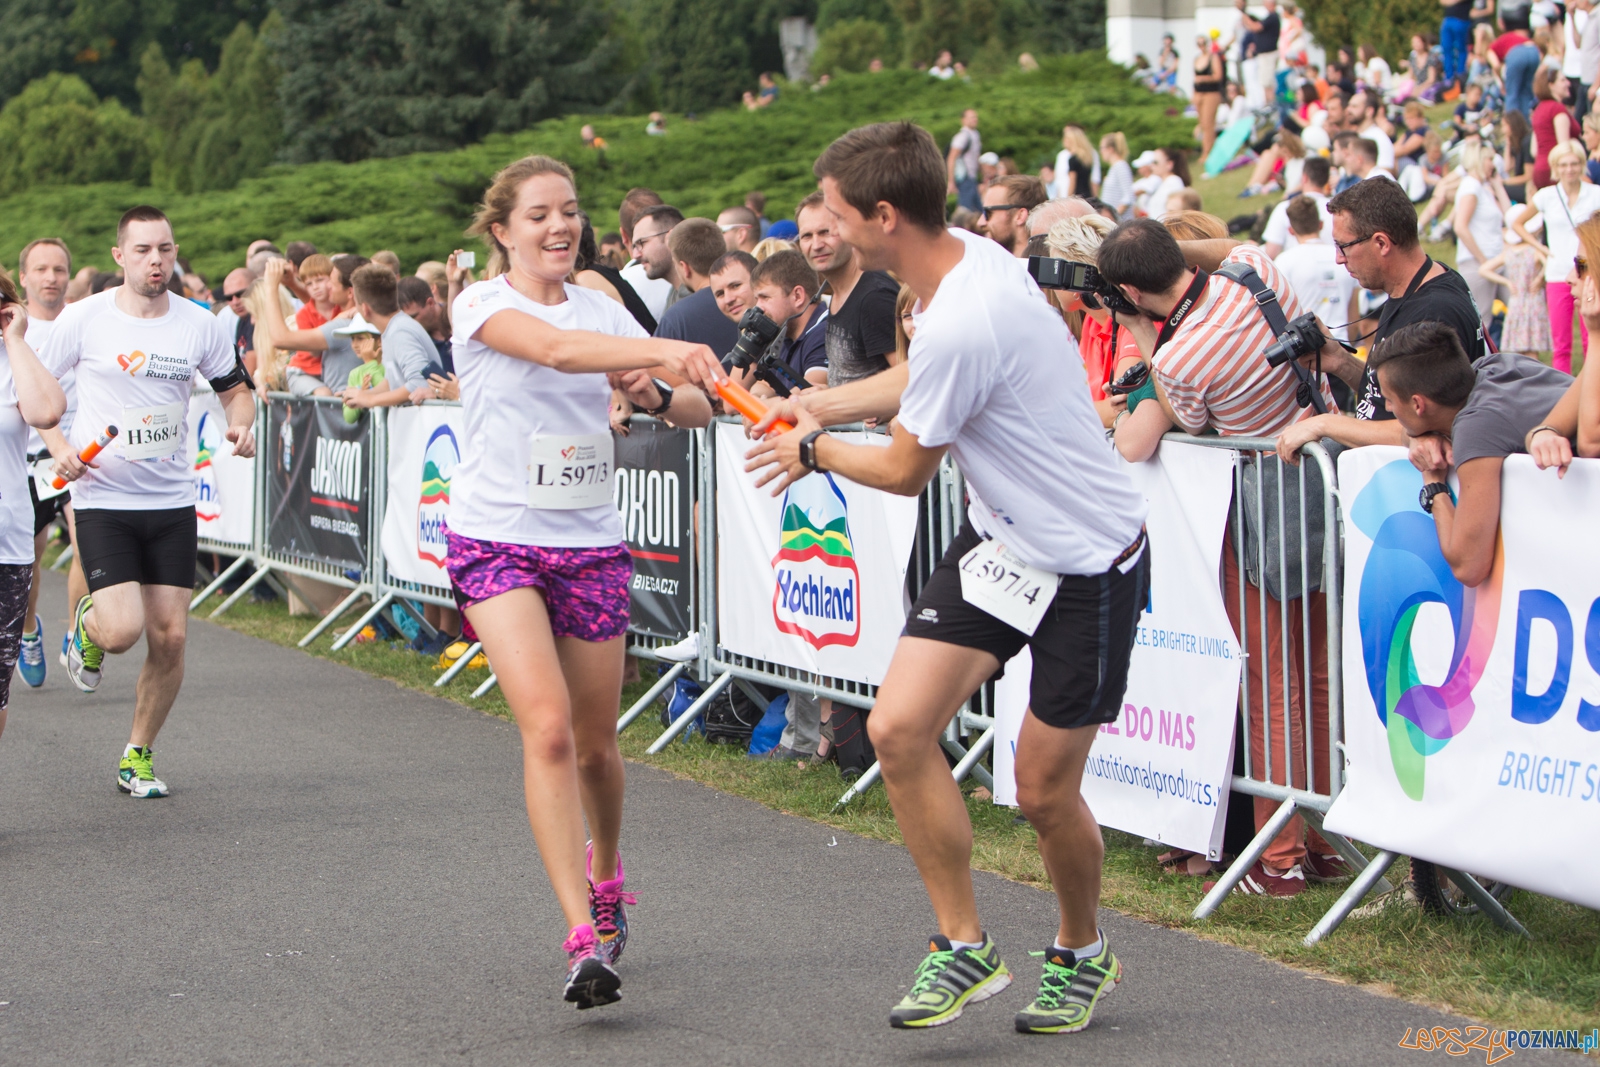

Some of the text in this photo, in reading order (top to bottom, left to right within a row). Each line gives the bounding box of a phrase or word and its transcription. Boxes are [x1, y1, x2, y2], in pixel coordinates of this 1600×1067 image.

[1170, 298, 1192, 326] Canon
[148, 361, 191, 374] Business
[150, 353, 188, 365] Poznań
[146, 369, 191, 382] Run 2016
[614, 467, 680, 548] AXON
[420, 511, 449, 545] Hochl
[632, 573, 680, 596] BIEGACZY
[1152, 628, 1197, 654] BRIGHTER
[1198, 636, 1233, 660] LIVING.
[1124, 703, 1153, 742] DO
[1159, 709, 1196, 751] NAS
[1498, 750, 1600, 803] BRIGHT S
